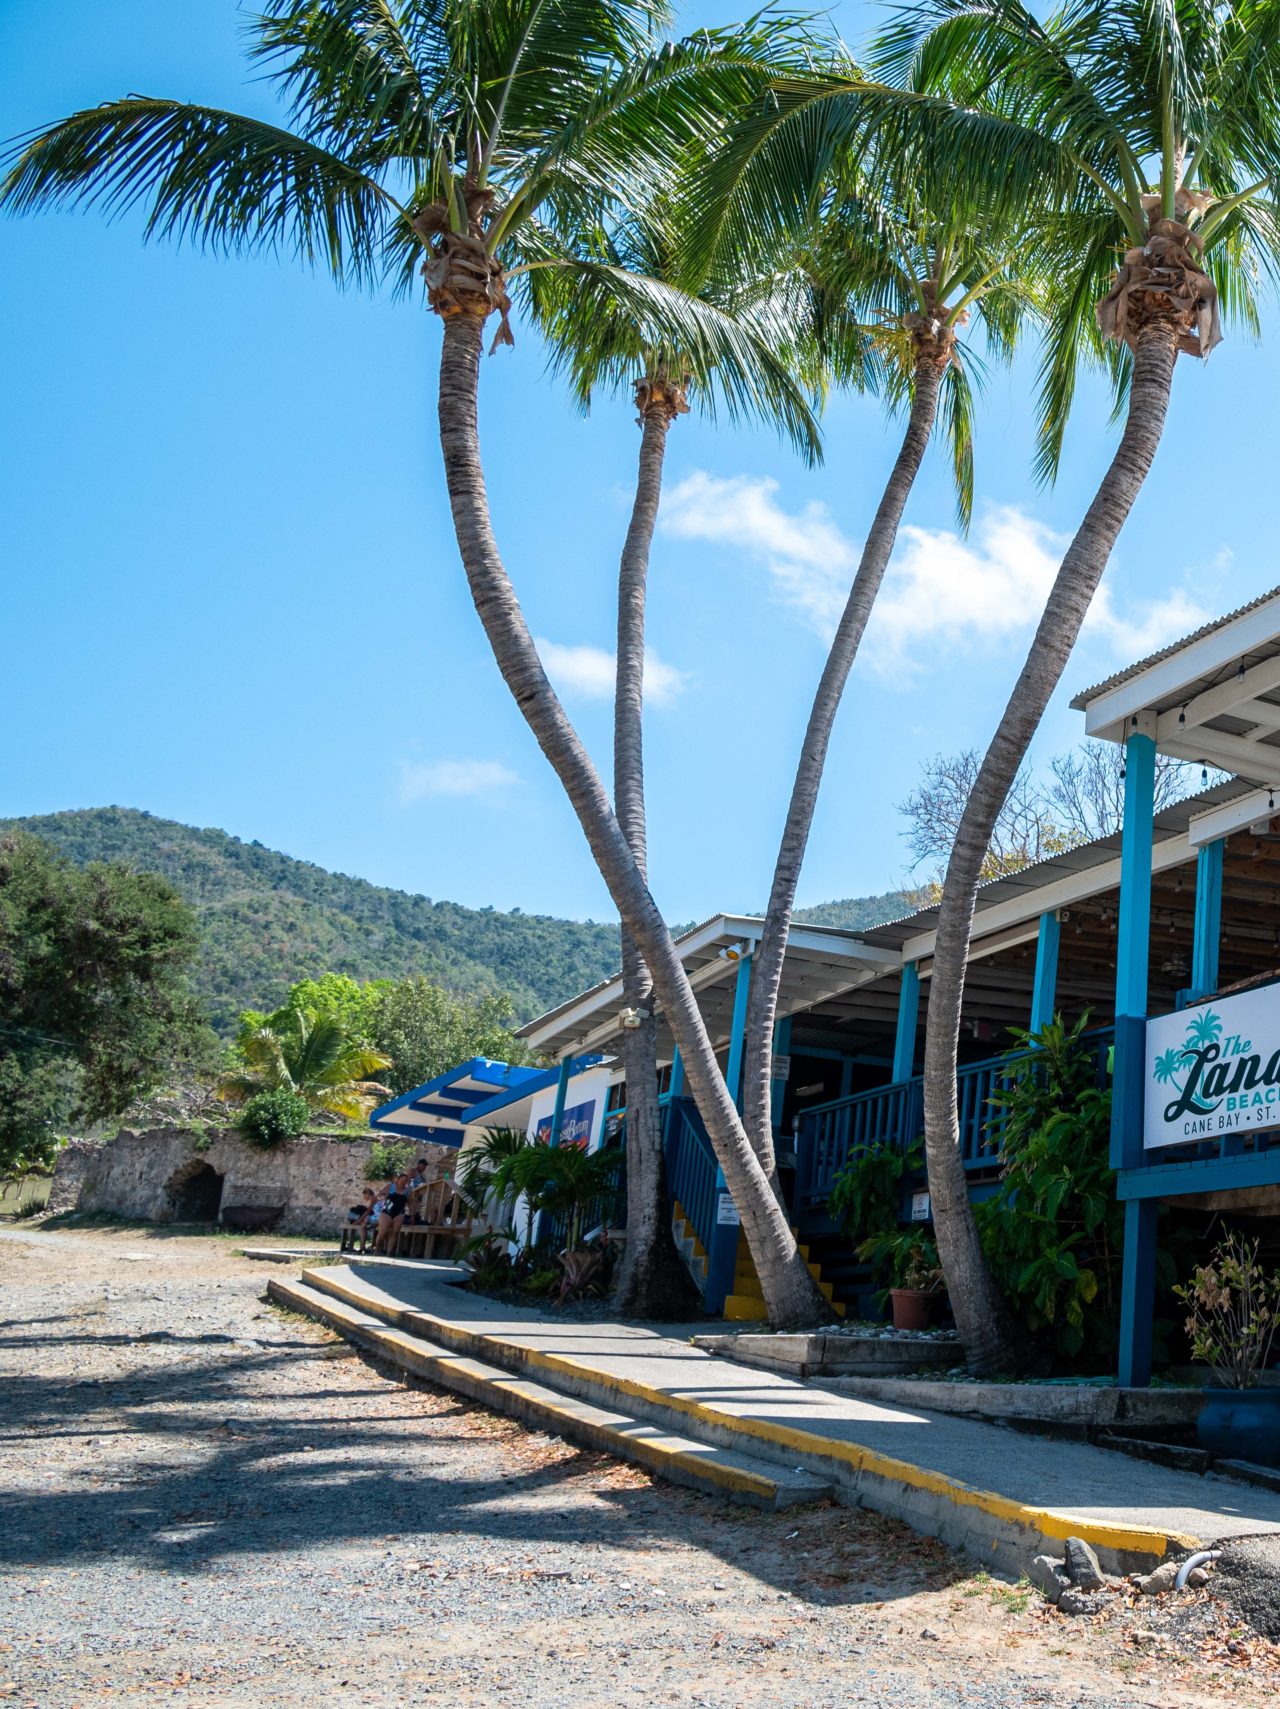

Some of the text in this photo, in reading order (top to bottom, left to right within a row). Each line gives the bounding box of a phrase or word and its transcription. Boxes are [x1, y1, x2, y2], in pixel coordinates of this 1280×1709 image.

[1222, 1035, 1252, 1058] The
[1184, 1118, 1213, 1135] CANE
[1218, 1112, 1240, 1128] BAY
[1257, 1106, 1275, 1121] ST.
